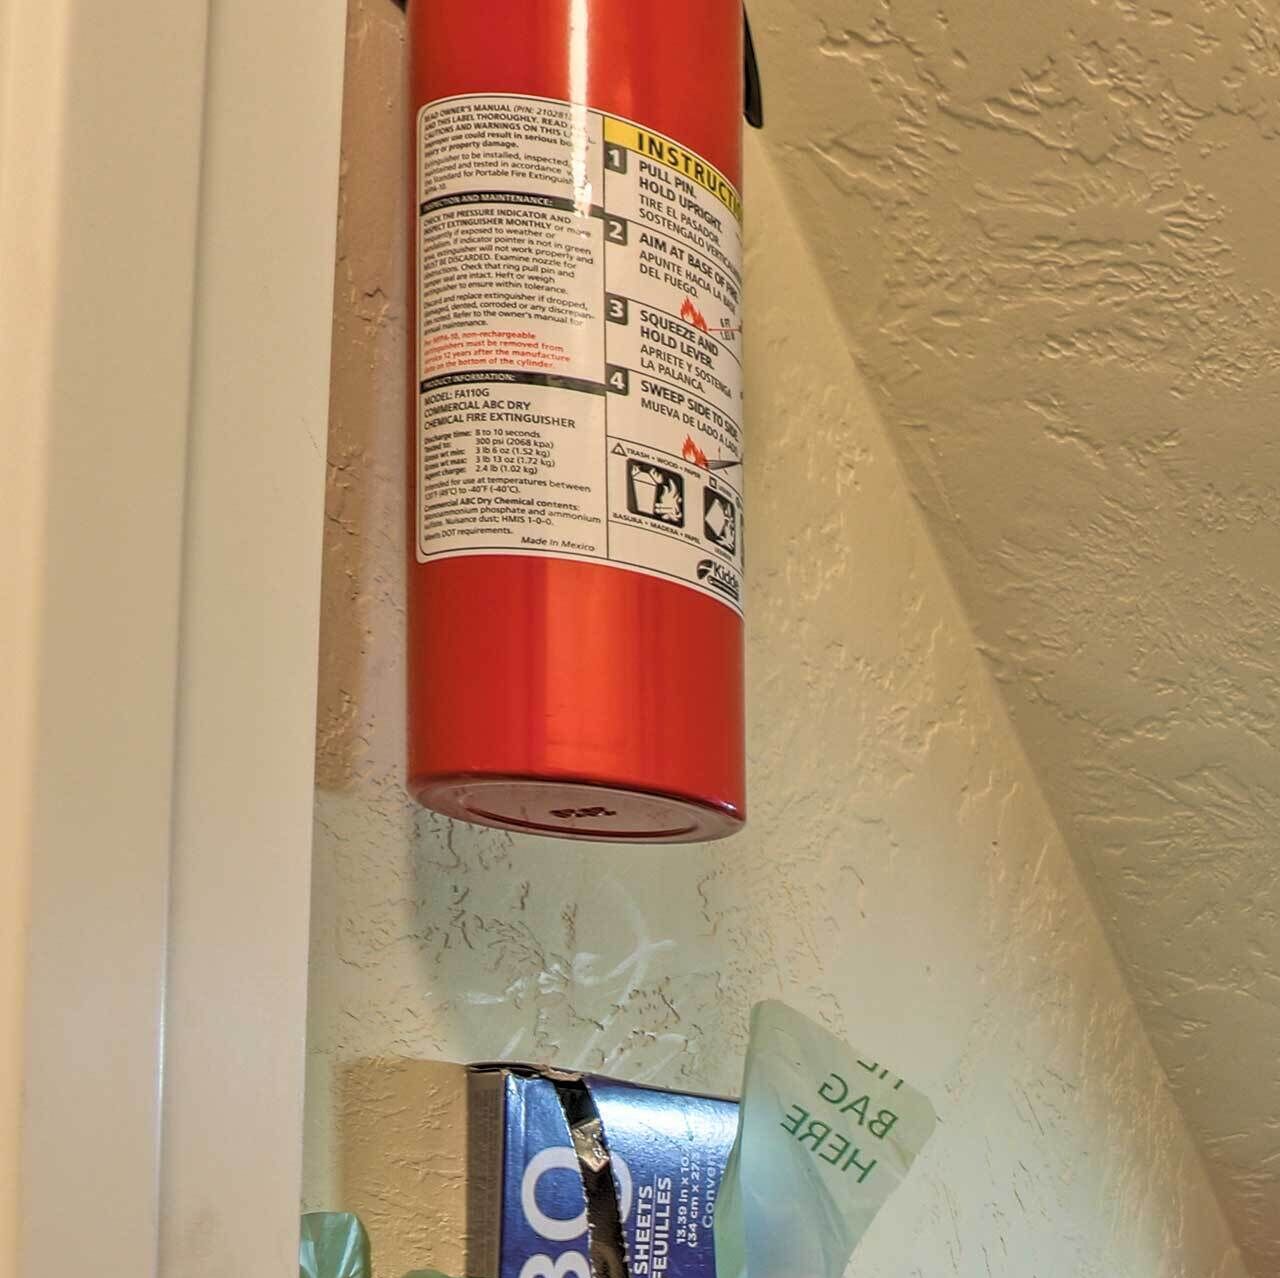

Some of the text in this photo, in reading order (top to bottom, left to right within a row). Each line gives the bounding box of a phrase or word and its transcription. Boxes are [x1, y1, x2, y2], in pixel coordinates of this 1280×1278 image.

[608, 149, 621, 167] 1
[640, 160, 671, 184] PULL
[640, 176, 675, 201] HOLD
[639, 194, 678, 220] TIRE EL
[609, 221, 623, 240] 2
[639, 208, 705, 247] SOSTENGALO
[640, 233, 667, 252] AIM
[669, 245, 685, 260] AT
[688, 253, 713, 279] BASE
[714, 273, 725, 287] OF
[640, 250, 682, 276] APUNTE
[685, 270, 711, 293] HACIA
[640, 263, 662, 280] DEL
[609, 299, 623, 318] 3
[640, 310, 718, 356] SQUEEZE AND
[640, 326, 677, 349] HOLD
[640, 344, 685, 369] APRIETE
[685, 363, 693, 372] Y
[640, 357, 655, 371] LA
[610, 371, 624, 390] 4
[454, 387, 490, 399] FA110G
[641, 380, 723, 428] SWEEP SIDE TO
[482, 400, 504, 410] ABC
[507, 401, 531, 411] DRY
[466, 413, 487, 422] FIRE
[490, 413, 576, 428] EXTINGUISHER
[641, 398, 719, 440] MUEVA DE LADO
[521, 537, 595, 551] Made Mexico
[634, 1186, 653, 1275] SHEETS
